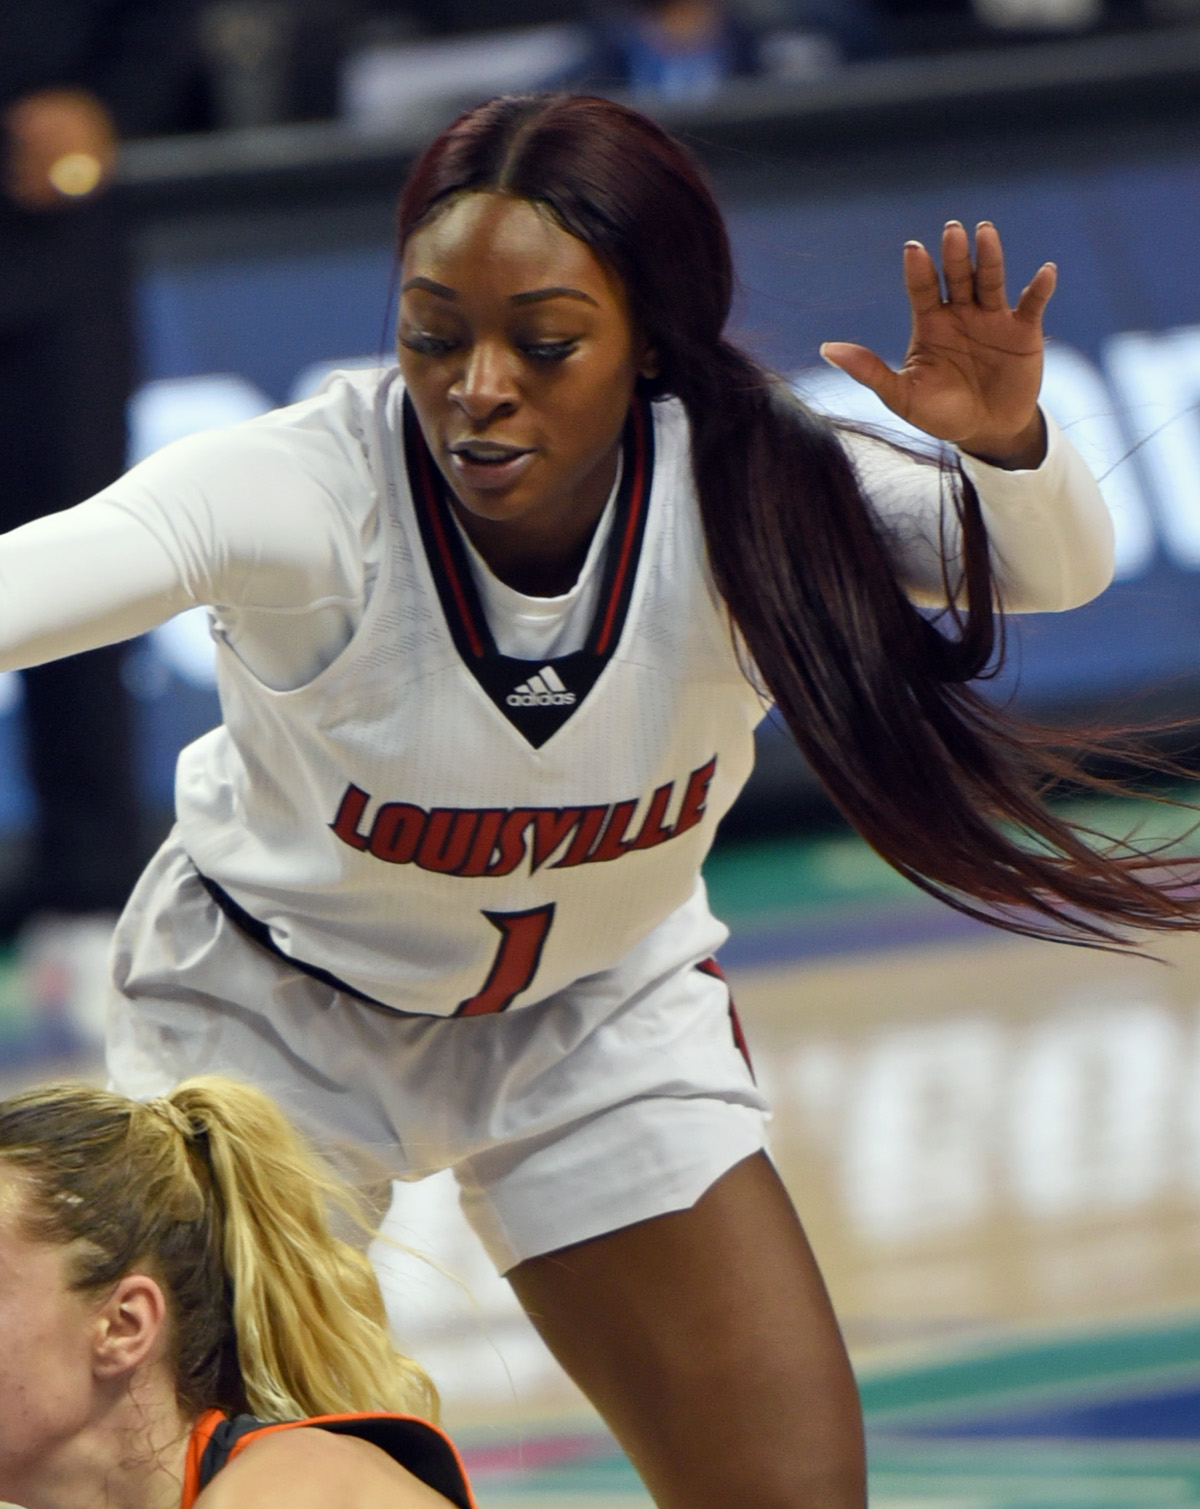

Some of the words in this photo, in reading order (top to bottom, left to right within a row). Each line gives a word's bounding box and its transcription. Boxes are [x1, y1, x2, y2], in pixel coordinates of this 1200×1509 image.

[506, 691, 577, 707] adidas
[328, 753, 718, 878] LOUISVILLE
[450, 901, 557, 1019] 1
